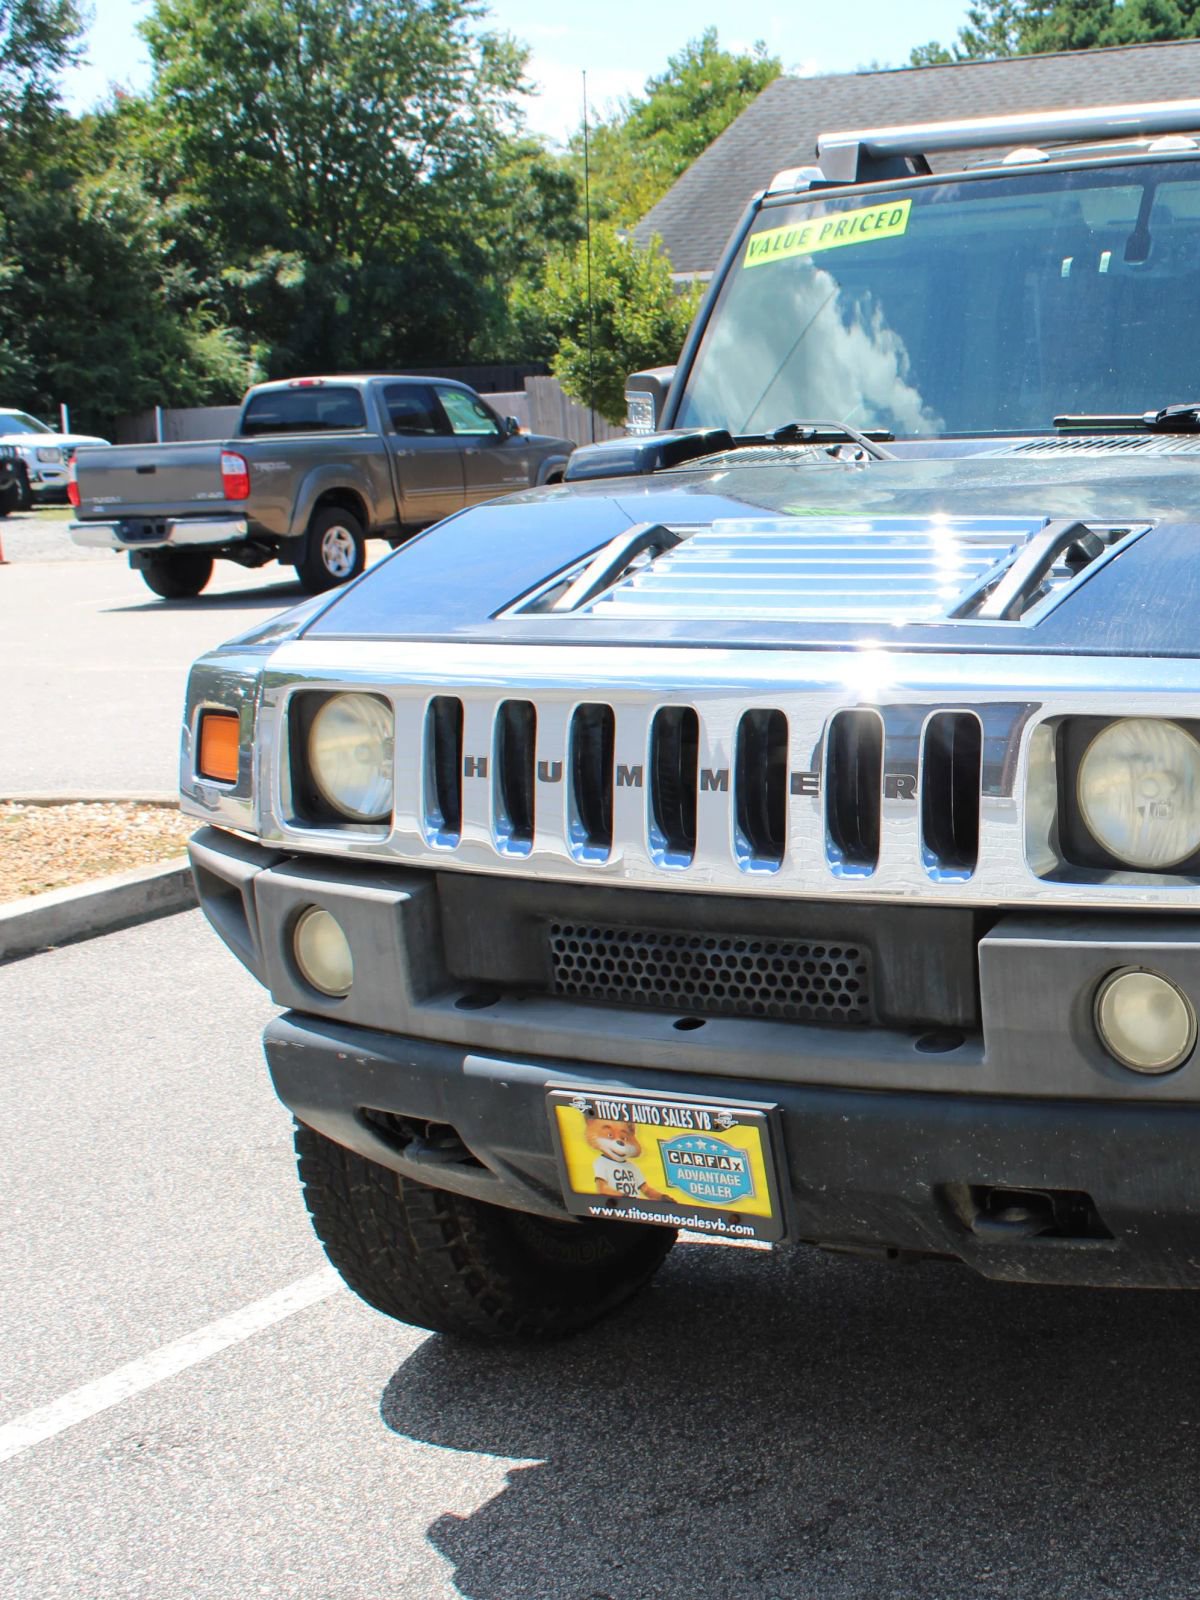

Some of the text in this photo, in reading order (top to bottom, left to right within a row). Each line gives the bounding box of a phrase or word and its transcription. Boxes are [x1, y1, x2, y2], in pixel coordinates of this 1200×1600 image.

[750, 208, 903, 257] VALUE PRICED
[463, 755, 917, 800] HUMMER
[595, 1101, 712, 1131] TITO'S AUTO SALES VB
[668, 1150, 744, 1173] CARFAX
[613, 1169, 635, 1183] CAR
[677, 1168, 741, 1187] ADVANTAGE
[616, 1183, 637, 1195] FOX
[690, 1183, 732, 1198] DEALER
[588, 1205, 755, 1237] www.titosautosalesvb.com
